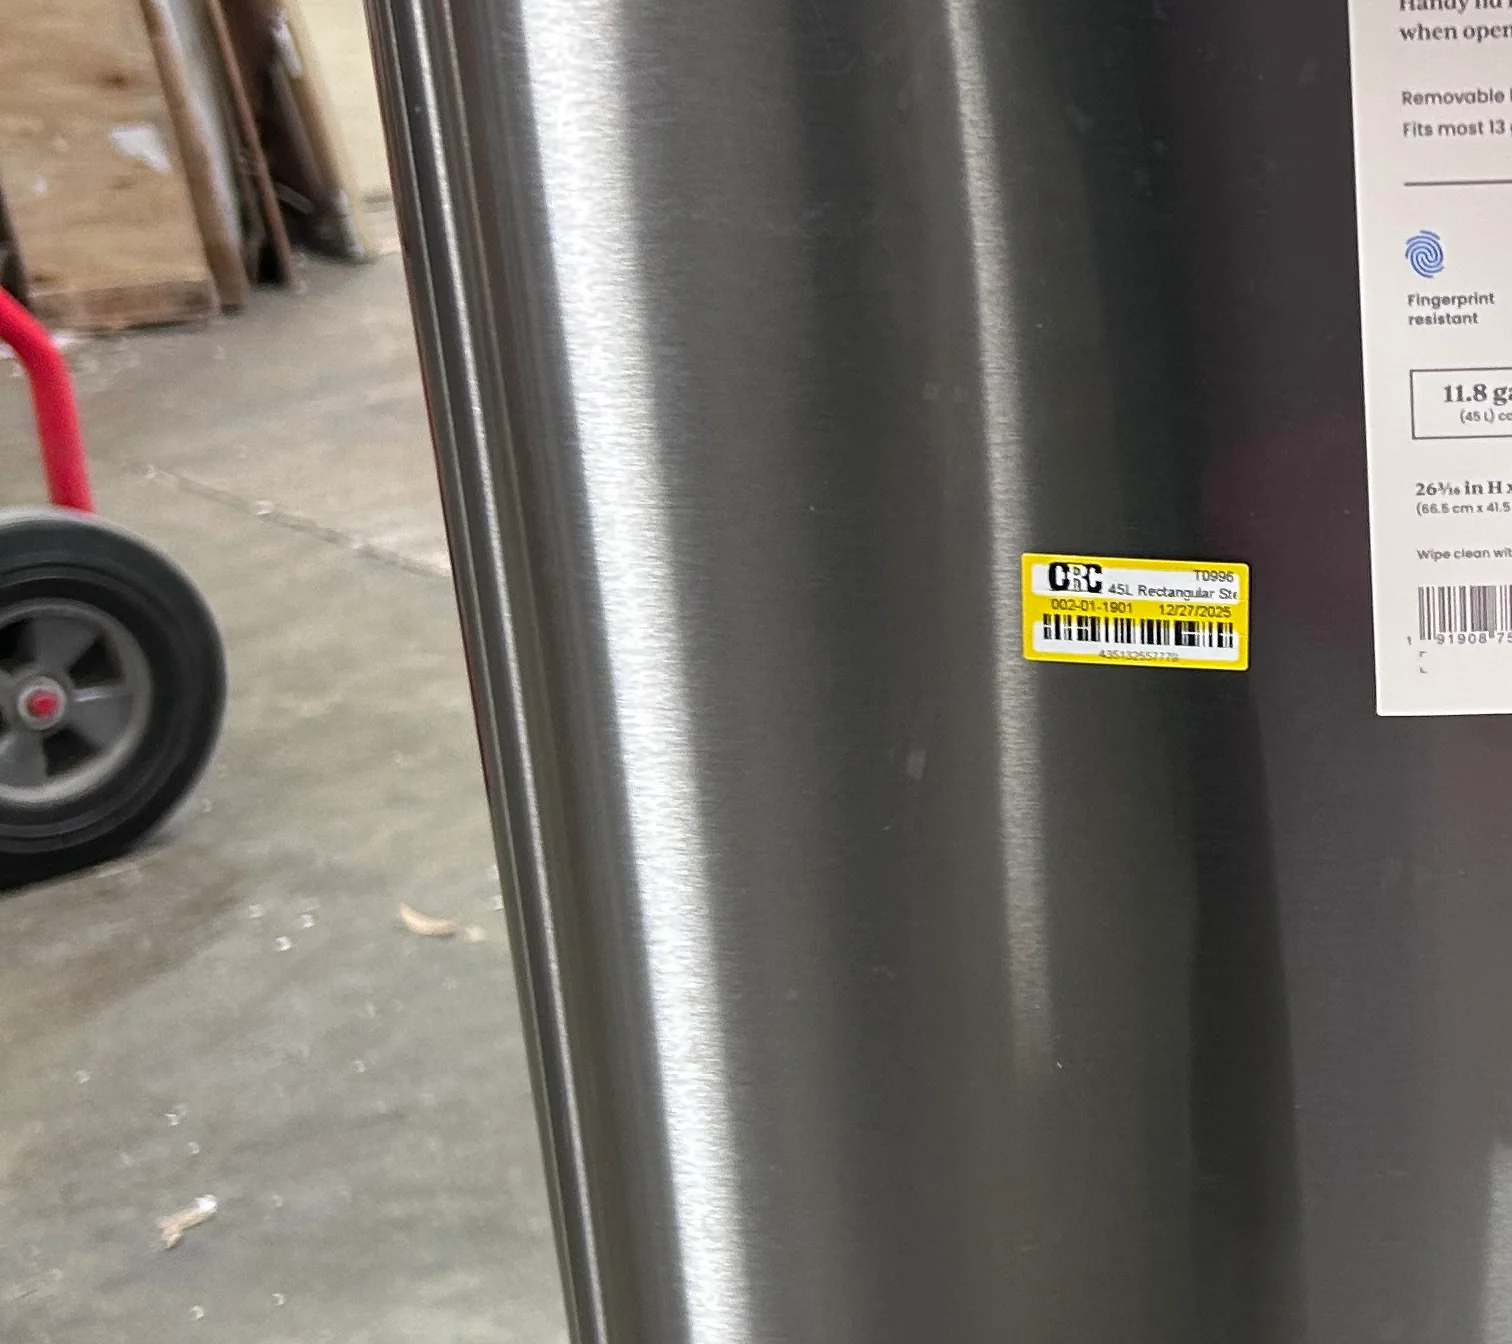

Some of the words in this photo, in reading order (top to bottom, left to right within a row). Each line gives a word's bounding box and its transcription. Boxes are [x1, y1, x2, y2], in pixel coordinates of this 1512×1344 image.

[1400, 23, 1457, 41] when
[1401, 88, 1505, 106] Removable
[1403, 121, 1433, 138] Fits
[1438, 120, 1484, 136] most
[1489, 118, 1506, 135] 13
[1407, 292, 1495, 310] Fingerprint
[1408, 311, 1479, 326] resistant
[1444, 382, 1488, 403] 11.8
[1464, 480, 1484, 496] in
[1487, 479, 1503, 495] H
[1452, 503, 1474, 514] cm
[1417, 548, 1451, 562] Wipe
[1453, 548, 1491, 559] clean
[1049, 562, 1103, 593] CRC
[1138, 585, 1214, 601] Rectangular
